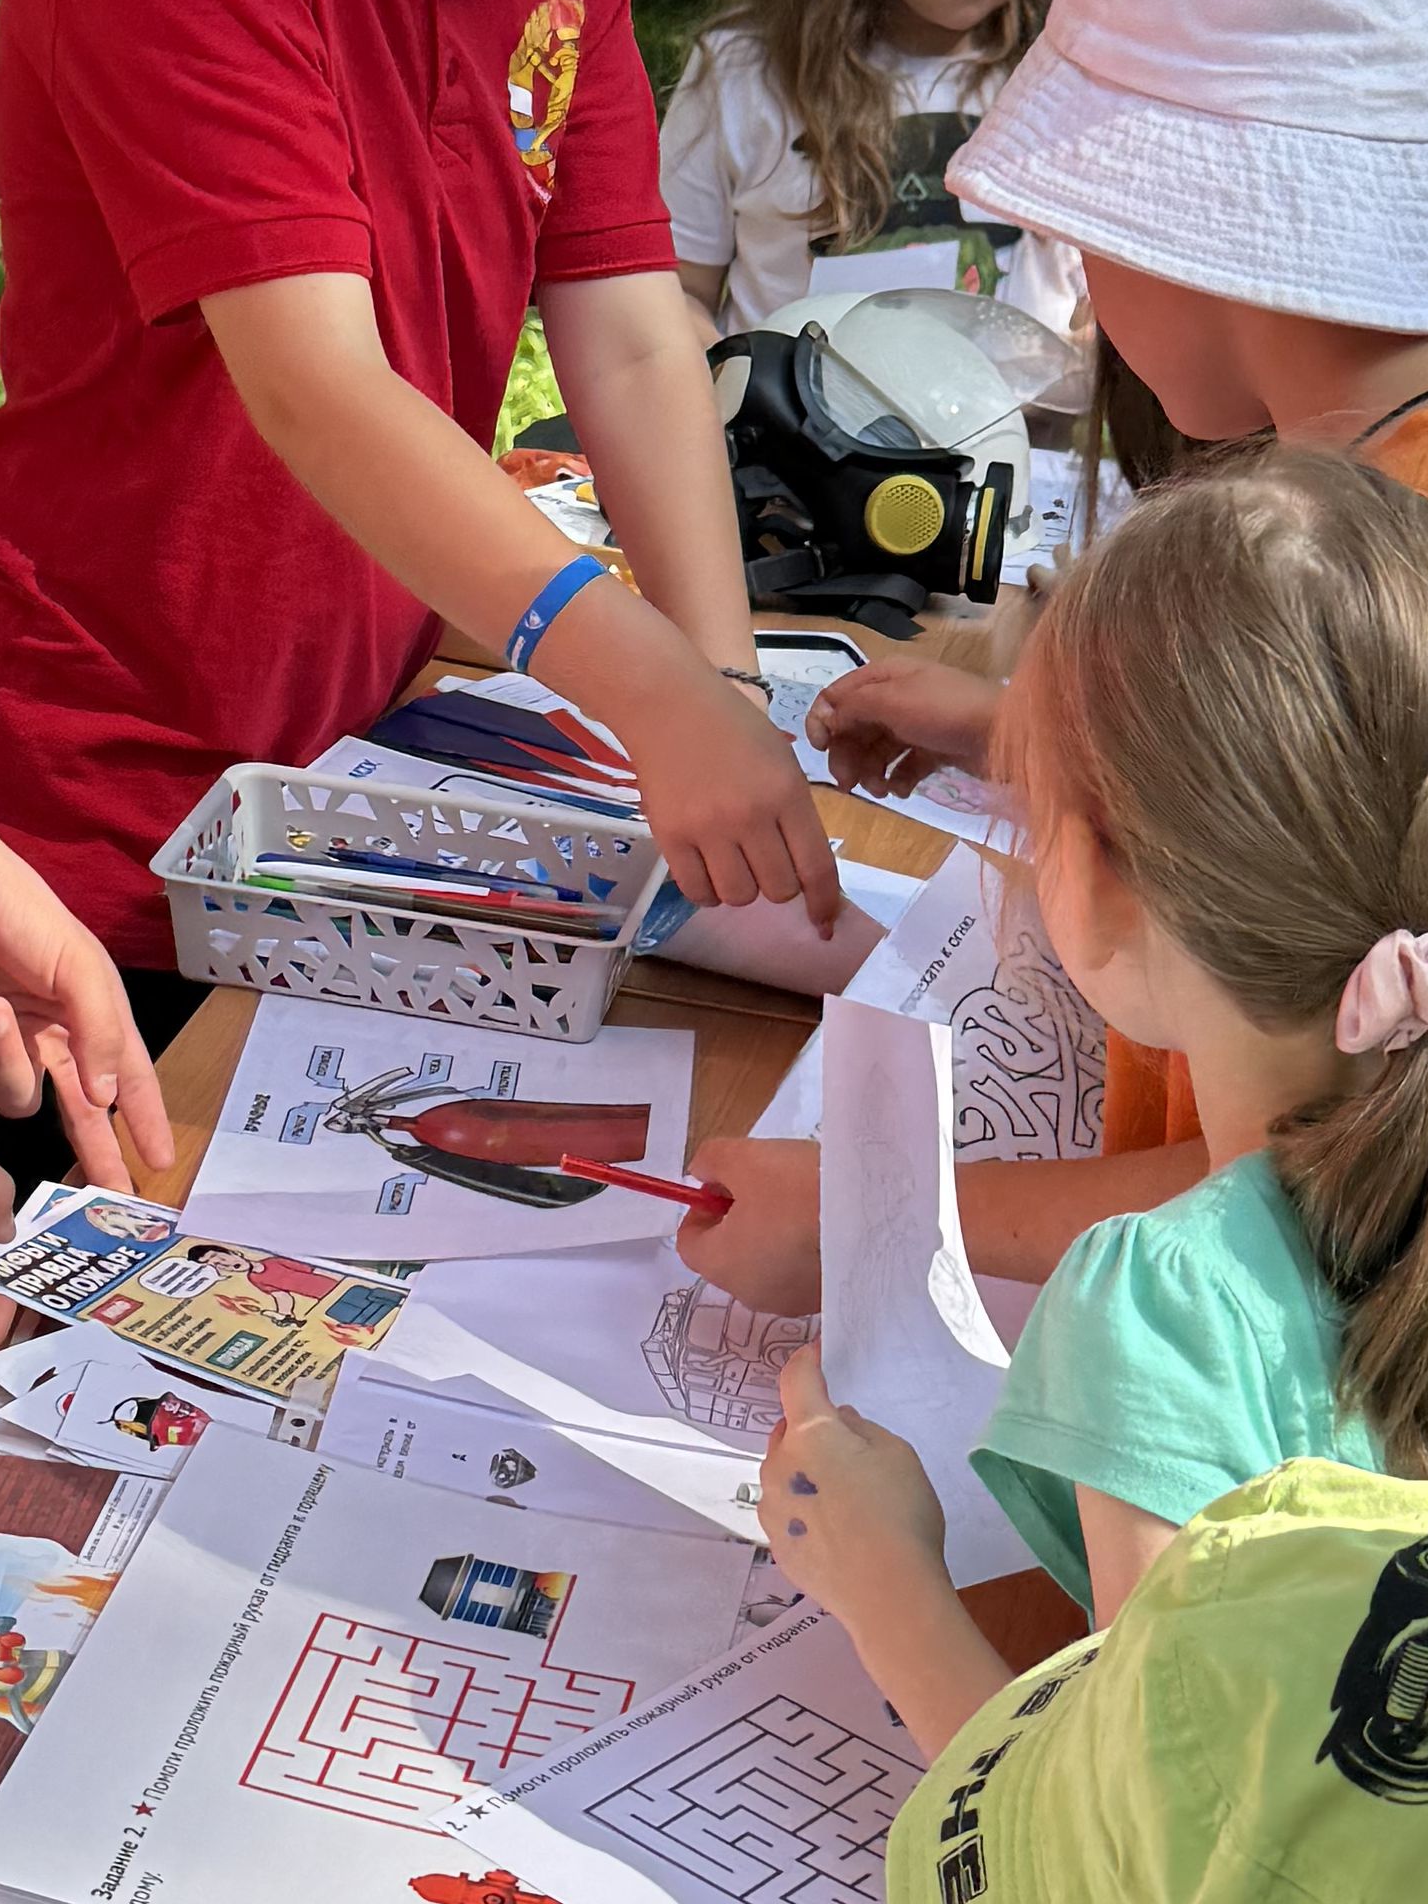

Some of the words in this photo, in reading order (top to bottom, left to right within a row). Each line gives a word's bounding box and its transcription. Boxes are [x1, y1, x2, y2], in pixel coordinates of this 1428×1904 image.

[37, 1231, 68, 1248] И
[6, 1246, 97, 1297] ПРАВДА
[41, 1294, 71, 1310] О
[56, 1246, 146, 1300] ПОЖАРЕ
[297, 1463, 336, 1514] горящему
[293, 1514, 306, 1523] к
[267, 1524, 301, 1573] гидранта
[260, 1573, 276, 1586] от
[242, 1588, 269, 1623] рукав
[209, 1622, 251, 1683] пожарный
[175, 1685, 219, 1750] проложить
[486, 1774, 552, 1809] Помоги
[549, 1729, 629, 1773] проложить
[627, 1685, 702, 1730] пожарный
[700, 1662, 741, 1690] рукав
[741, 1652, 758, 1664] от
[757, 1616, 819, 1654] гидранта
[142, 1752, 184, 1801] Помоги
[123, 1826, 147, 1838] 2.
[91, 1840, 139, 1901] Задание
